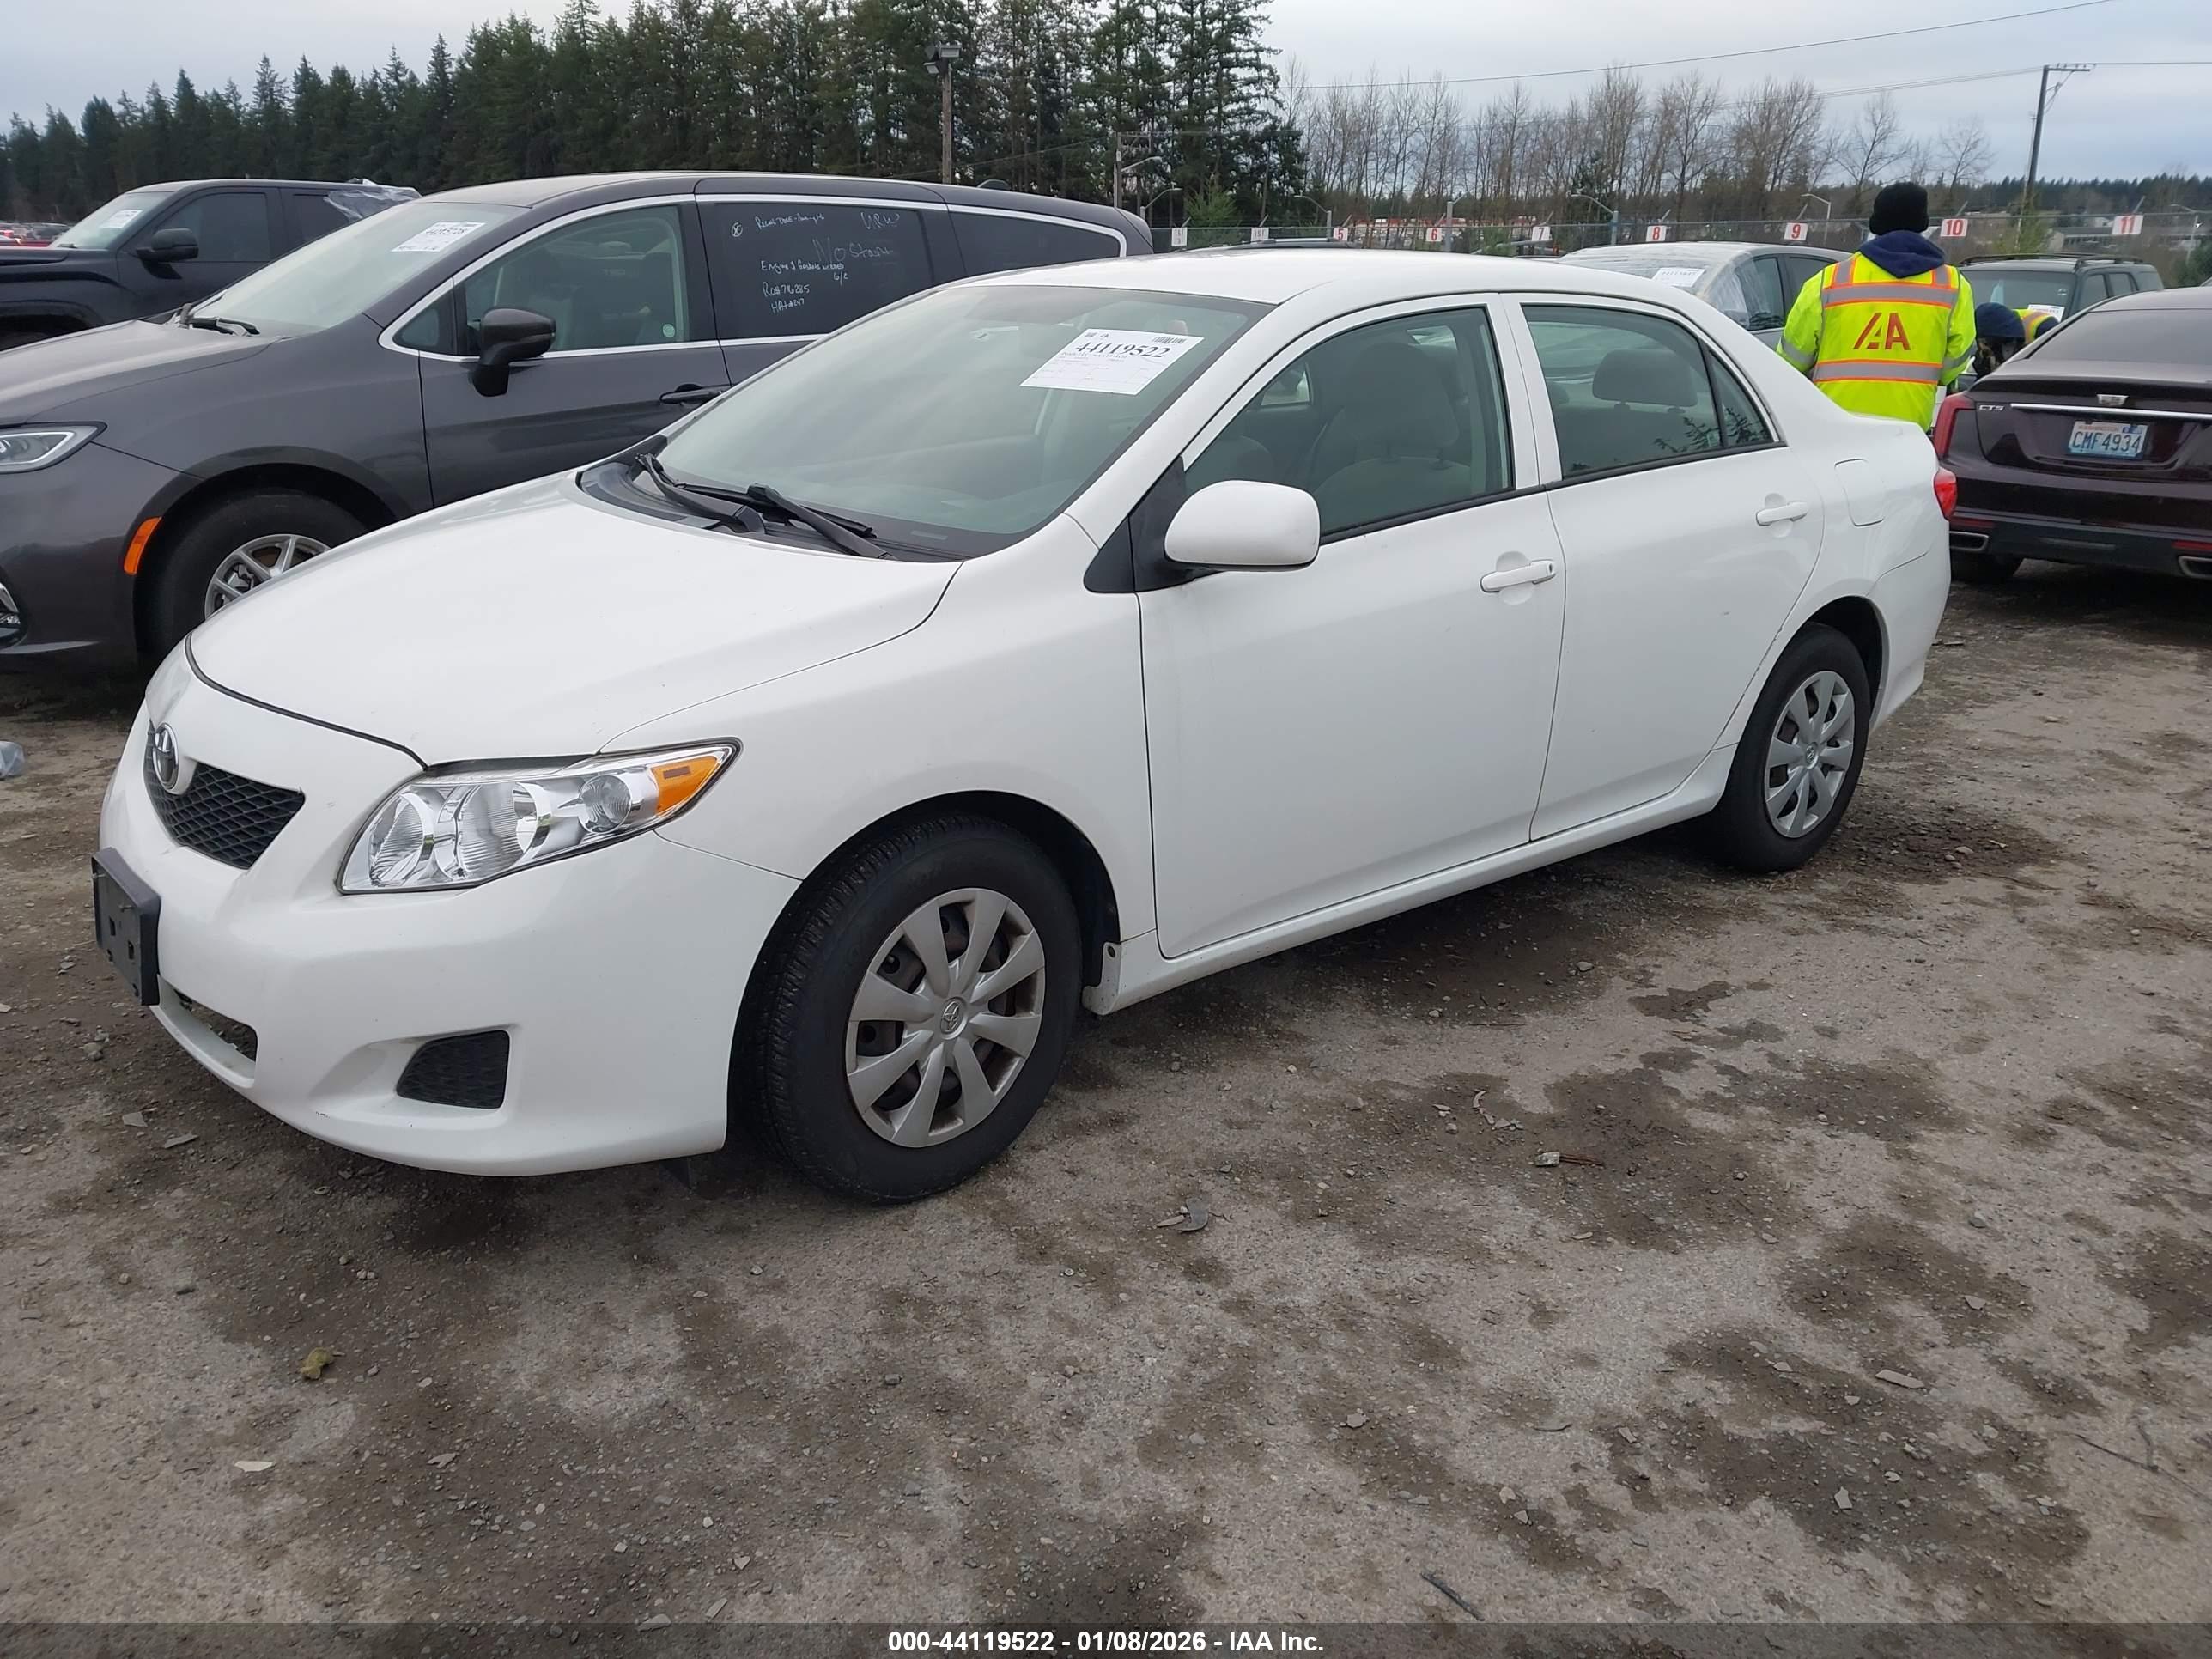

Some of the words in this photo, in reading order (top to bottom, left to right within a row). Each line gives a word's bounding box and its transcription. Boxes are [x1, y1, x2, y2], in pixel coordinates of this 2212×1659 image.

[1791, 224, 1801, 239] 9
[1946, 220, 1964, 235] 10
[2121, 216, 2136, 234] 11
[1337, 228, 1344, 240] 5
[1431, 228, 1438, 240] 6
[1538, 228, 1546, 240] 7
[1652, 226, 1662, 240] 8
[1075, 342, 1170, 358] 44119522
[2071, 431, 2142, 453] CMF4934
